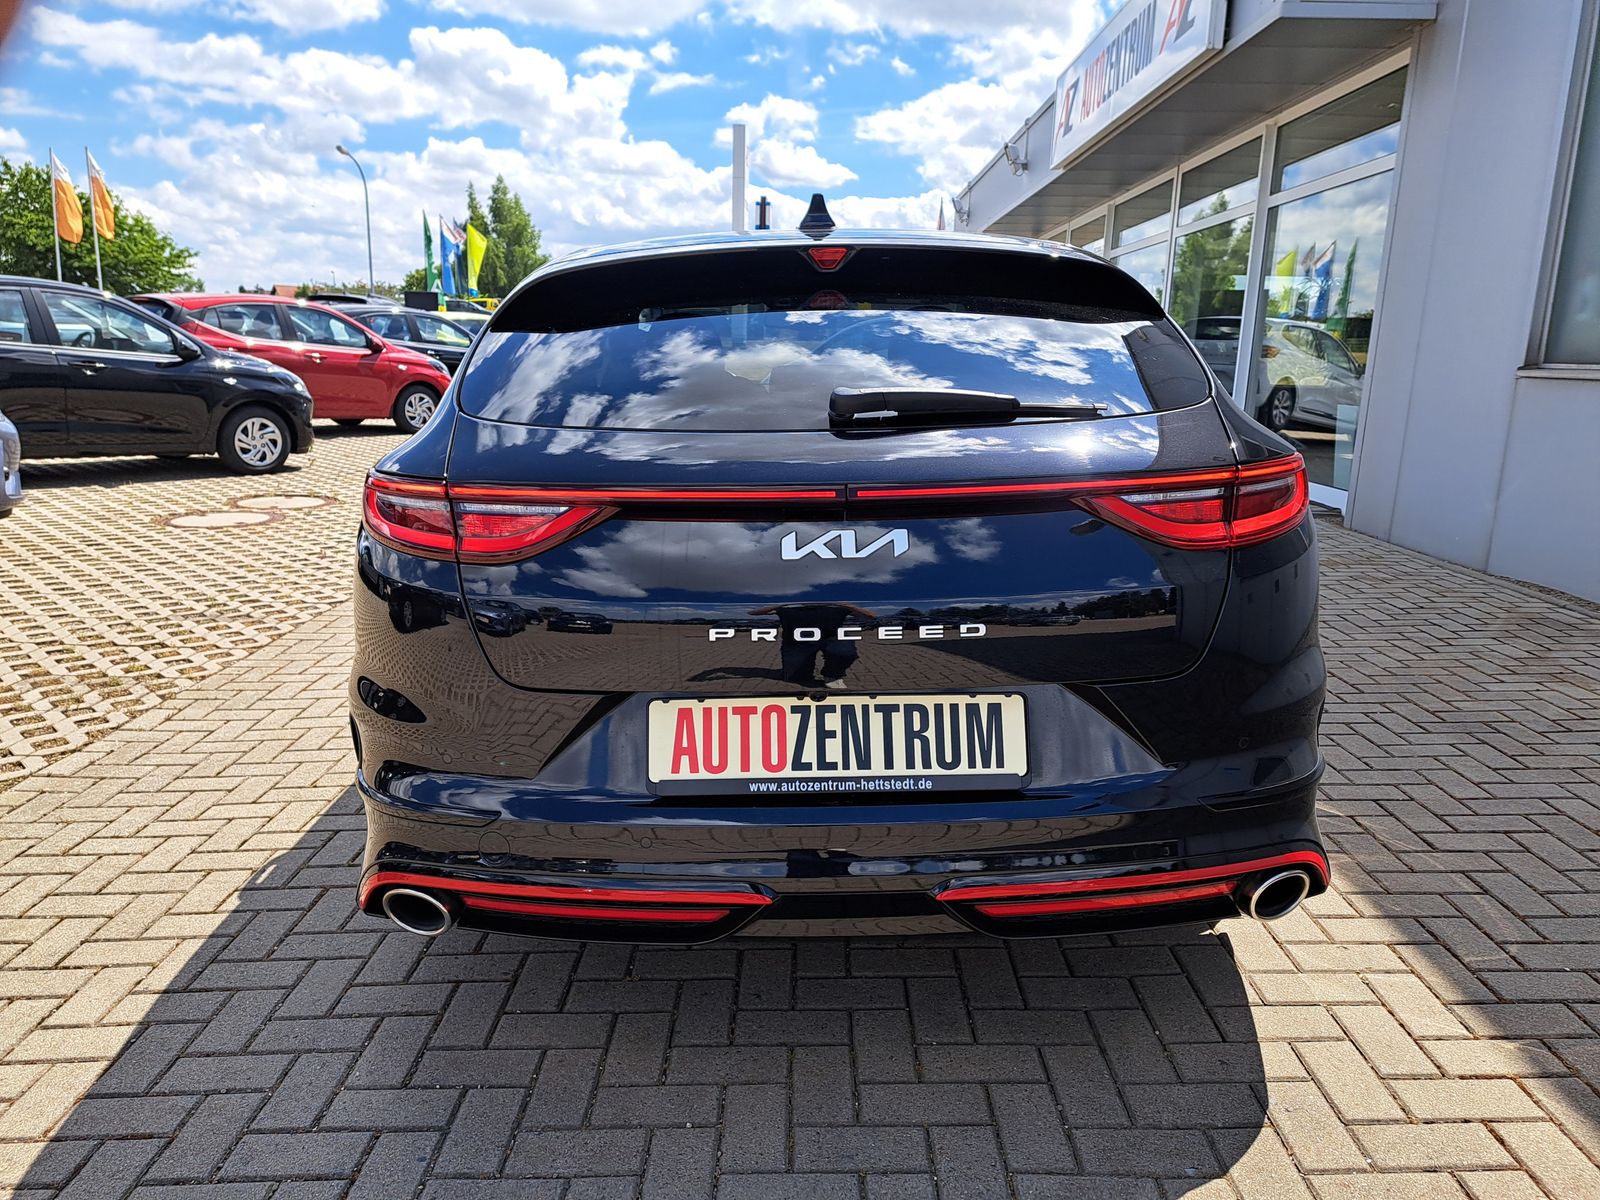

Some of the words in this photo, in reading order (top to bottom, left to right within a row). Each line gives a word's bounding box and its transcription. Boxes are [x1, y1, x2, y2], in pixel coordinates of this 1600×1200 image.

[1080, 0, 1157, 122] AUTOZENTRUM
[708, 623, 988, 643] PROCEED
[670, 702, 1005, 775] AUTOZENTRUM
[749, 778, 933, 793] www.autozentrum-hettstedt.de
